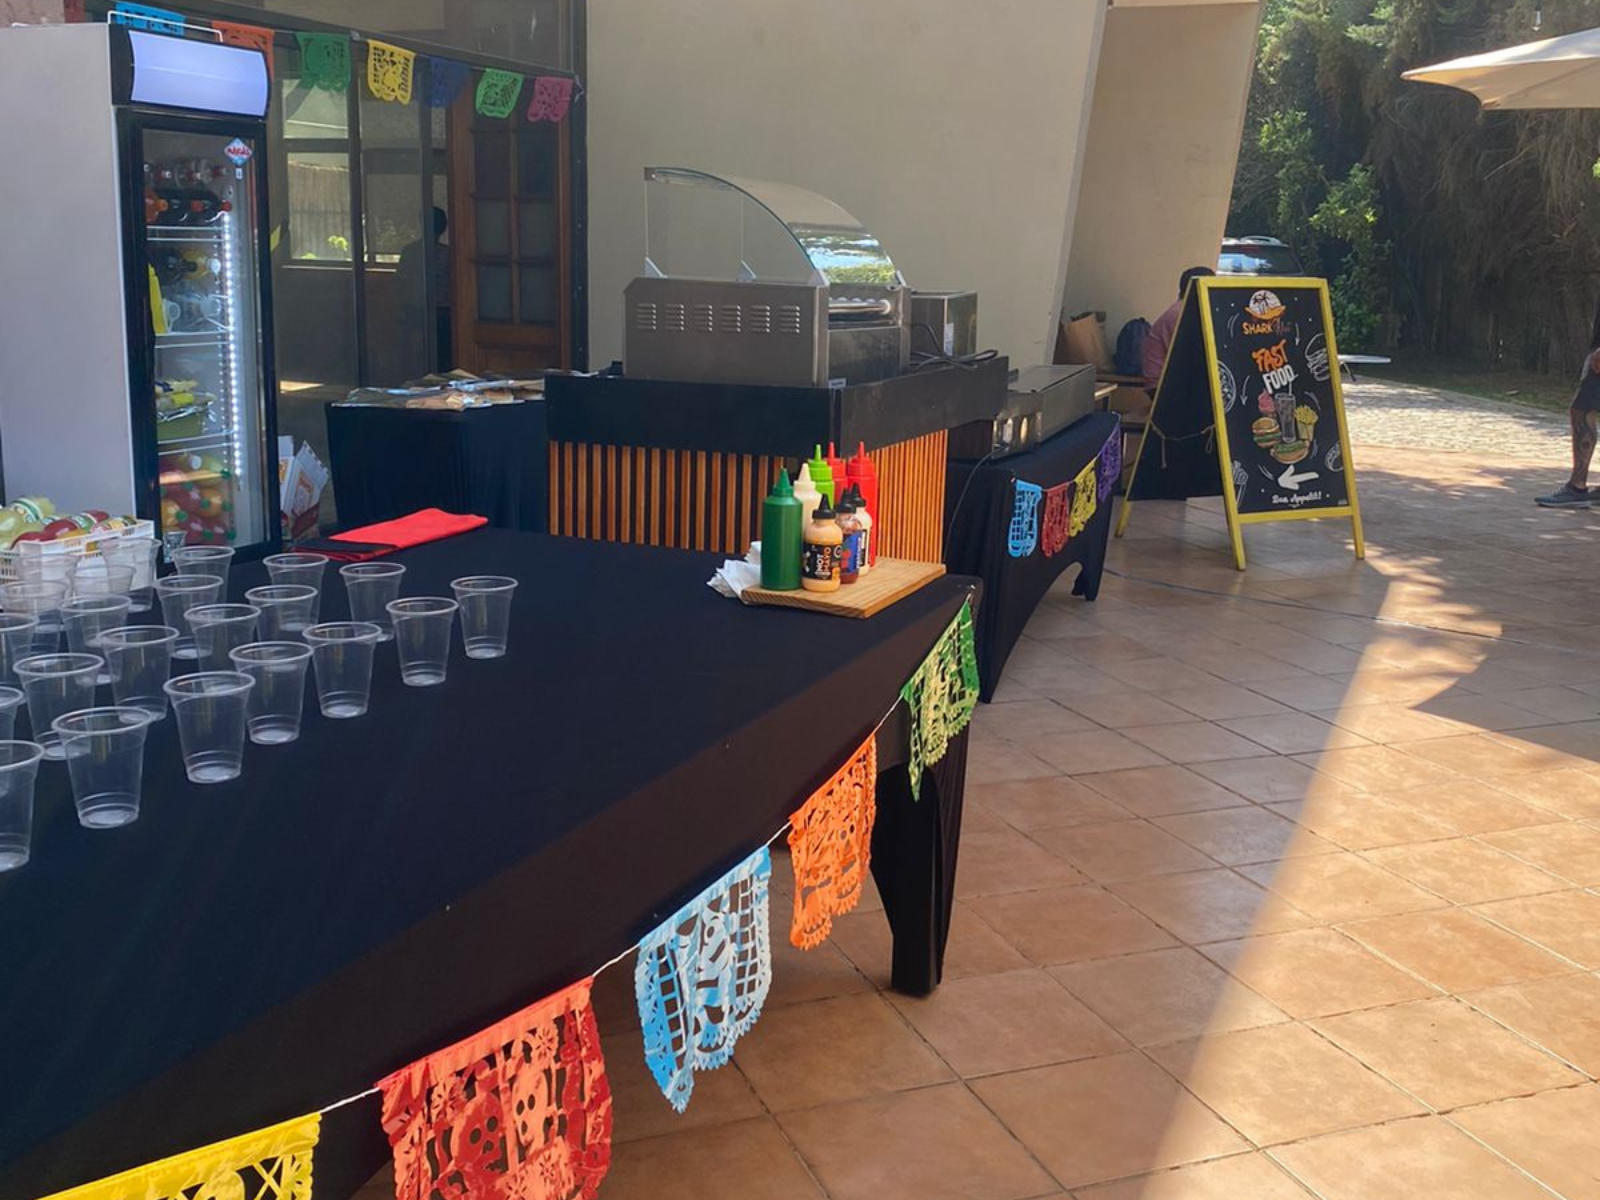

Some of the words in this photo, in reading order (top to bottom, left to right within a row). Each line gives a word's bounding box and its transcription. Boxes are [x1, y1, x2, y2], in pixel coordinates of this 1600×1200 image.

[1242, 321, 1273, 336] SHARK
[1252, 339, 1288, 372] FAST
[1263, 364, 1294, 395] FOOD
